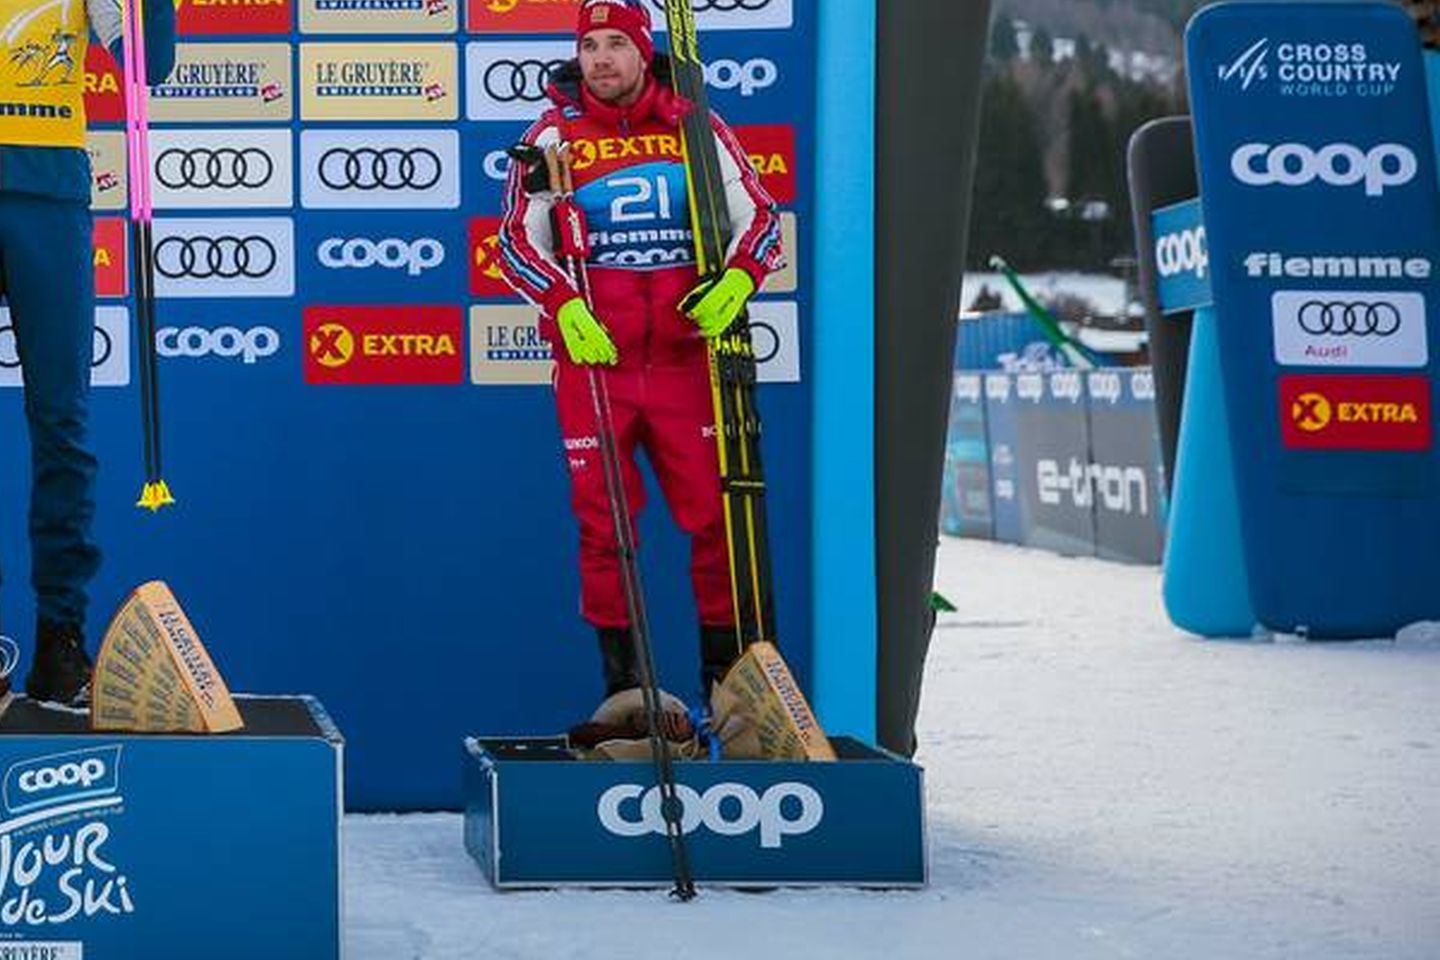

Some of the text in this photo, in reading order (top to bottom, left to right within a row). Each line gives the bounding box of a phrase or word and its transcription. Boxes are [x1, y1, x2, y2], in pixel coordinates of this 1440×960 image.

[1278, 45, 1367, 62] CROSS
[176, 61, 259, 84] GRUYÈRE
[317, 58, 426, 85] LE GRUYÈRE
[1278, 62, 1401, 81] COUNTRY
[1280, 84, 1395, 96] WORLD CUP
[600, 135, 682, 159] EXTR
[1231, 143, 1417, 197] coop
[607, 175, 670, 222] 21
[588, 228, 692, 246] fiemm
[318, 238, 445, 276] coop
[1244, 253, 1430, 278] fiemme
[155, 326, 280, 364] coop
[363, 335, 455, 356] EXTRA
[487, 326, 508, 347] LE
[1304, 344, 1348, 358] Audi
[1338, 402, 1417, 423] EXTRA
[1037, 457, 1147, 515] e-tron
[18, 757, 106, 793] coop
[598, 781, 825, 848] coop
[1, 868, 134, 925] de Ski
